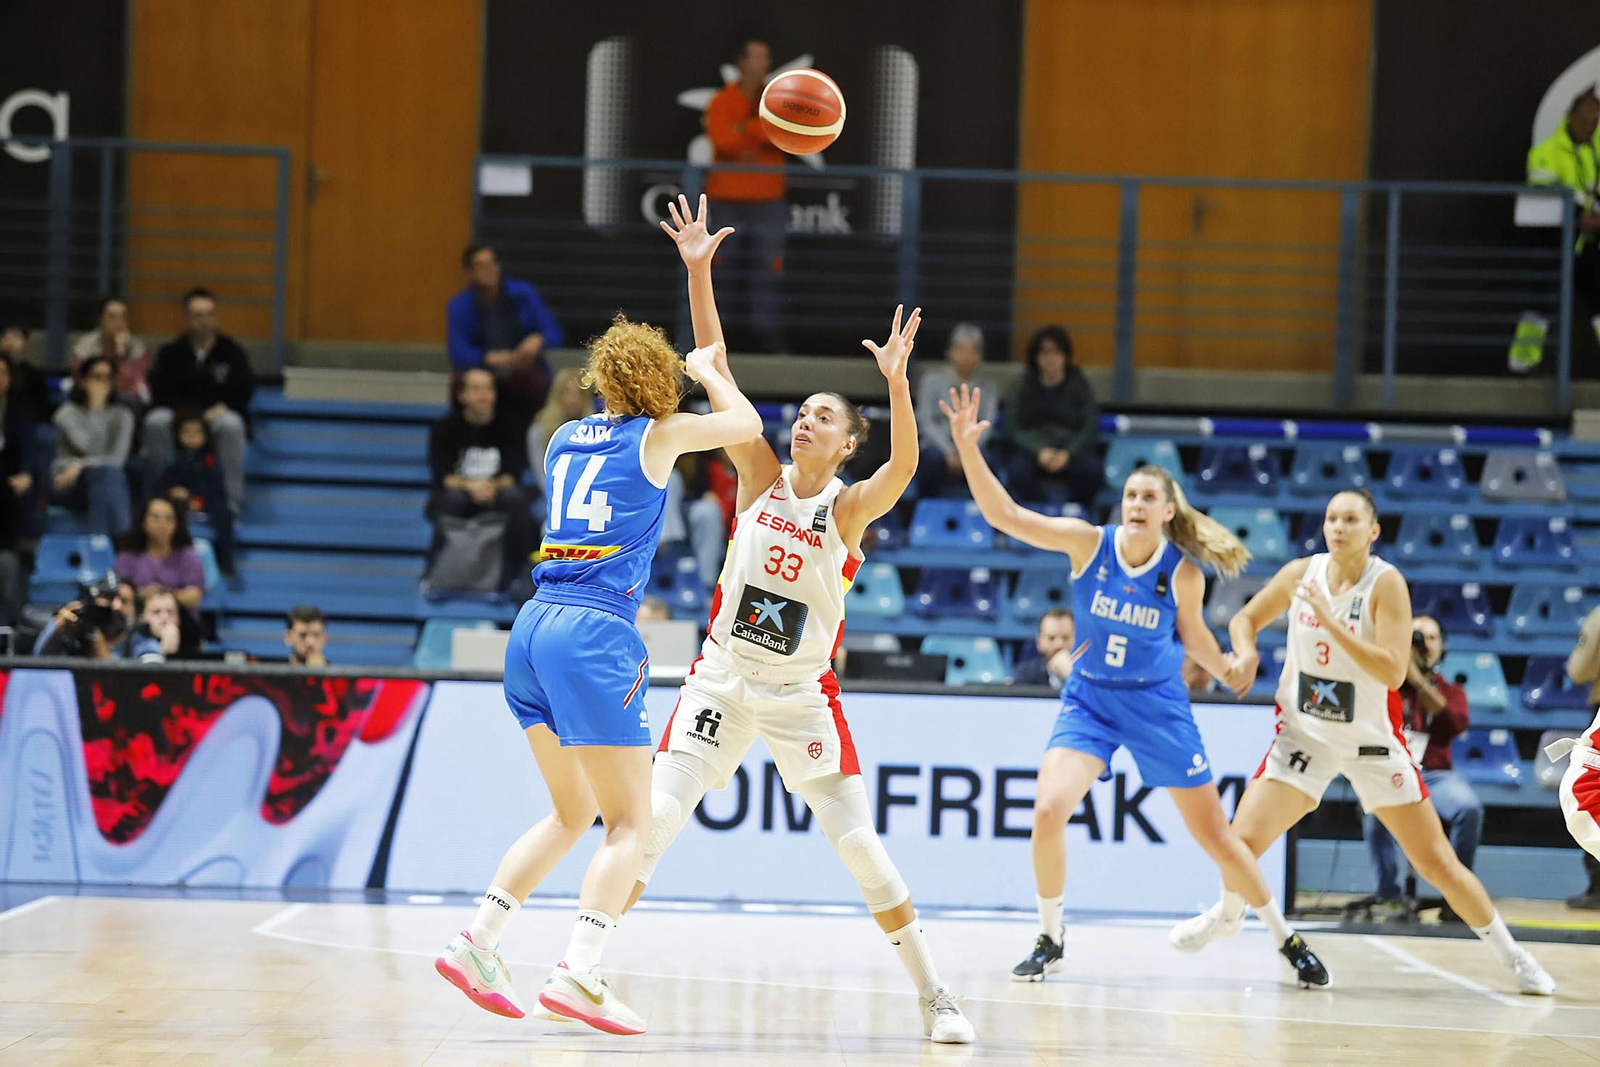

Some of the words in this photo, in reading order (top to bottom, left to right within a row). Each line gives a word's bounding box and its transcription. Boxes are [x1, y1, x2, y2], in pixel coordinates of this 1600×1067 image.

[551, 453, 612, 532] 14
[756, 511, 823, 549] ESPAÑA
[763, 545, 804, 583] 33
[1090, 589, 1160, 630] ÍSLAND
[733, 622, 788, 652] CaixaBank
[1104, 633, 1128, 668] 5
[1315, 640, 1330, 666] 3
[686, 731, 720, 748] network
[694, 708, 722, 738] fi
[876, 765, 1166, 843] FREAK
